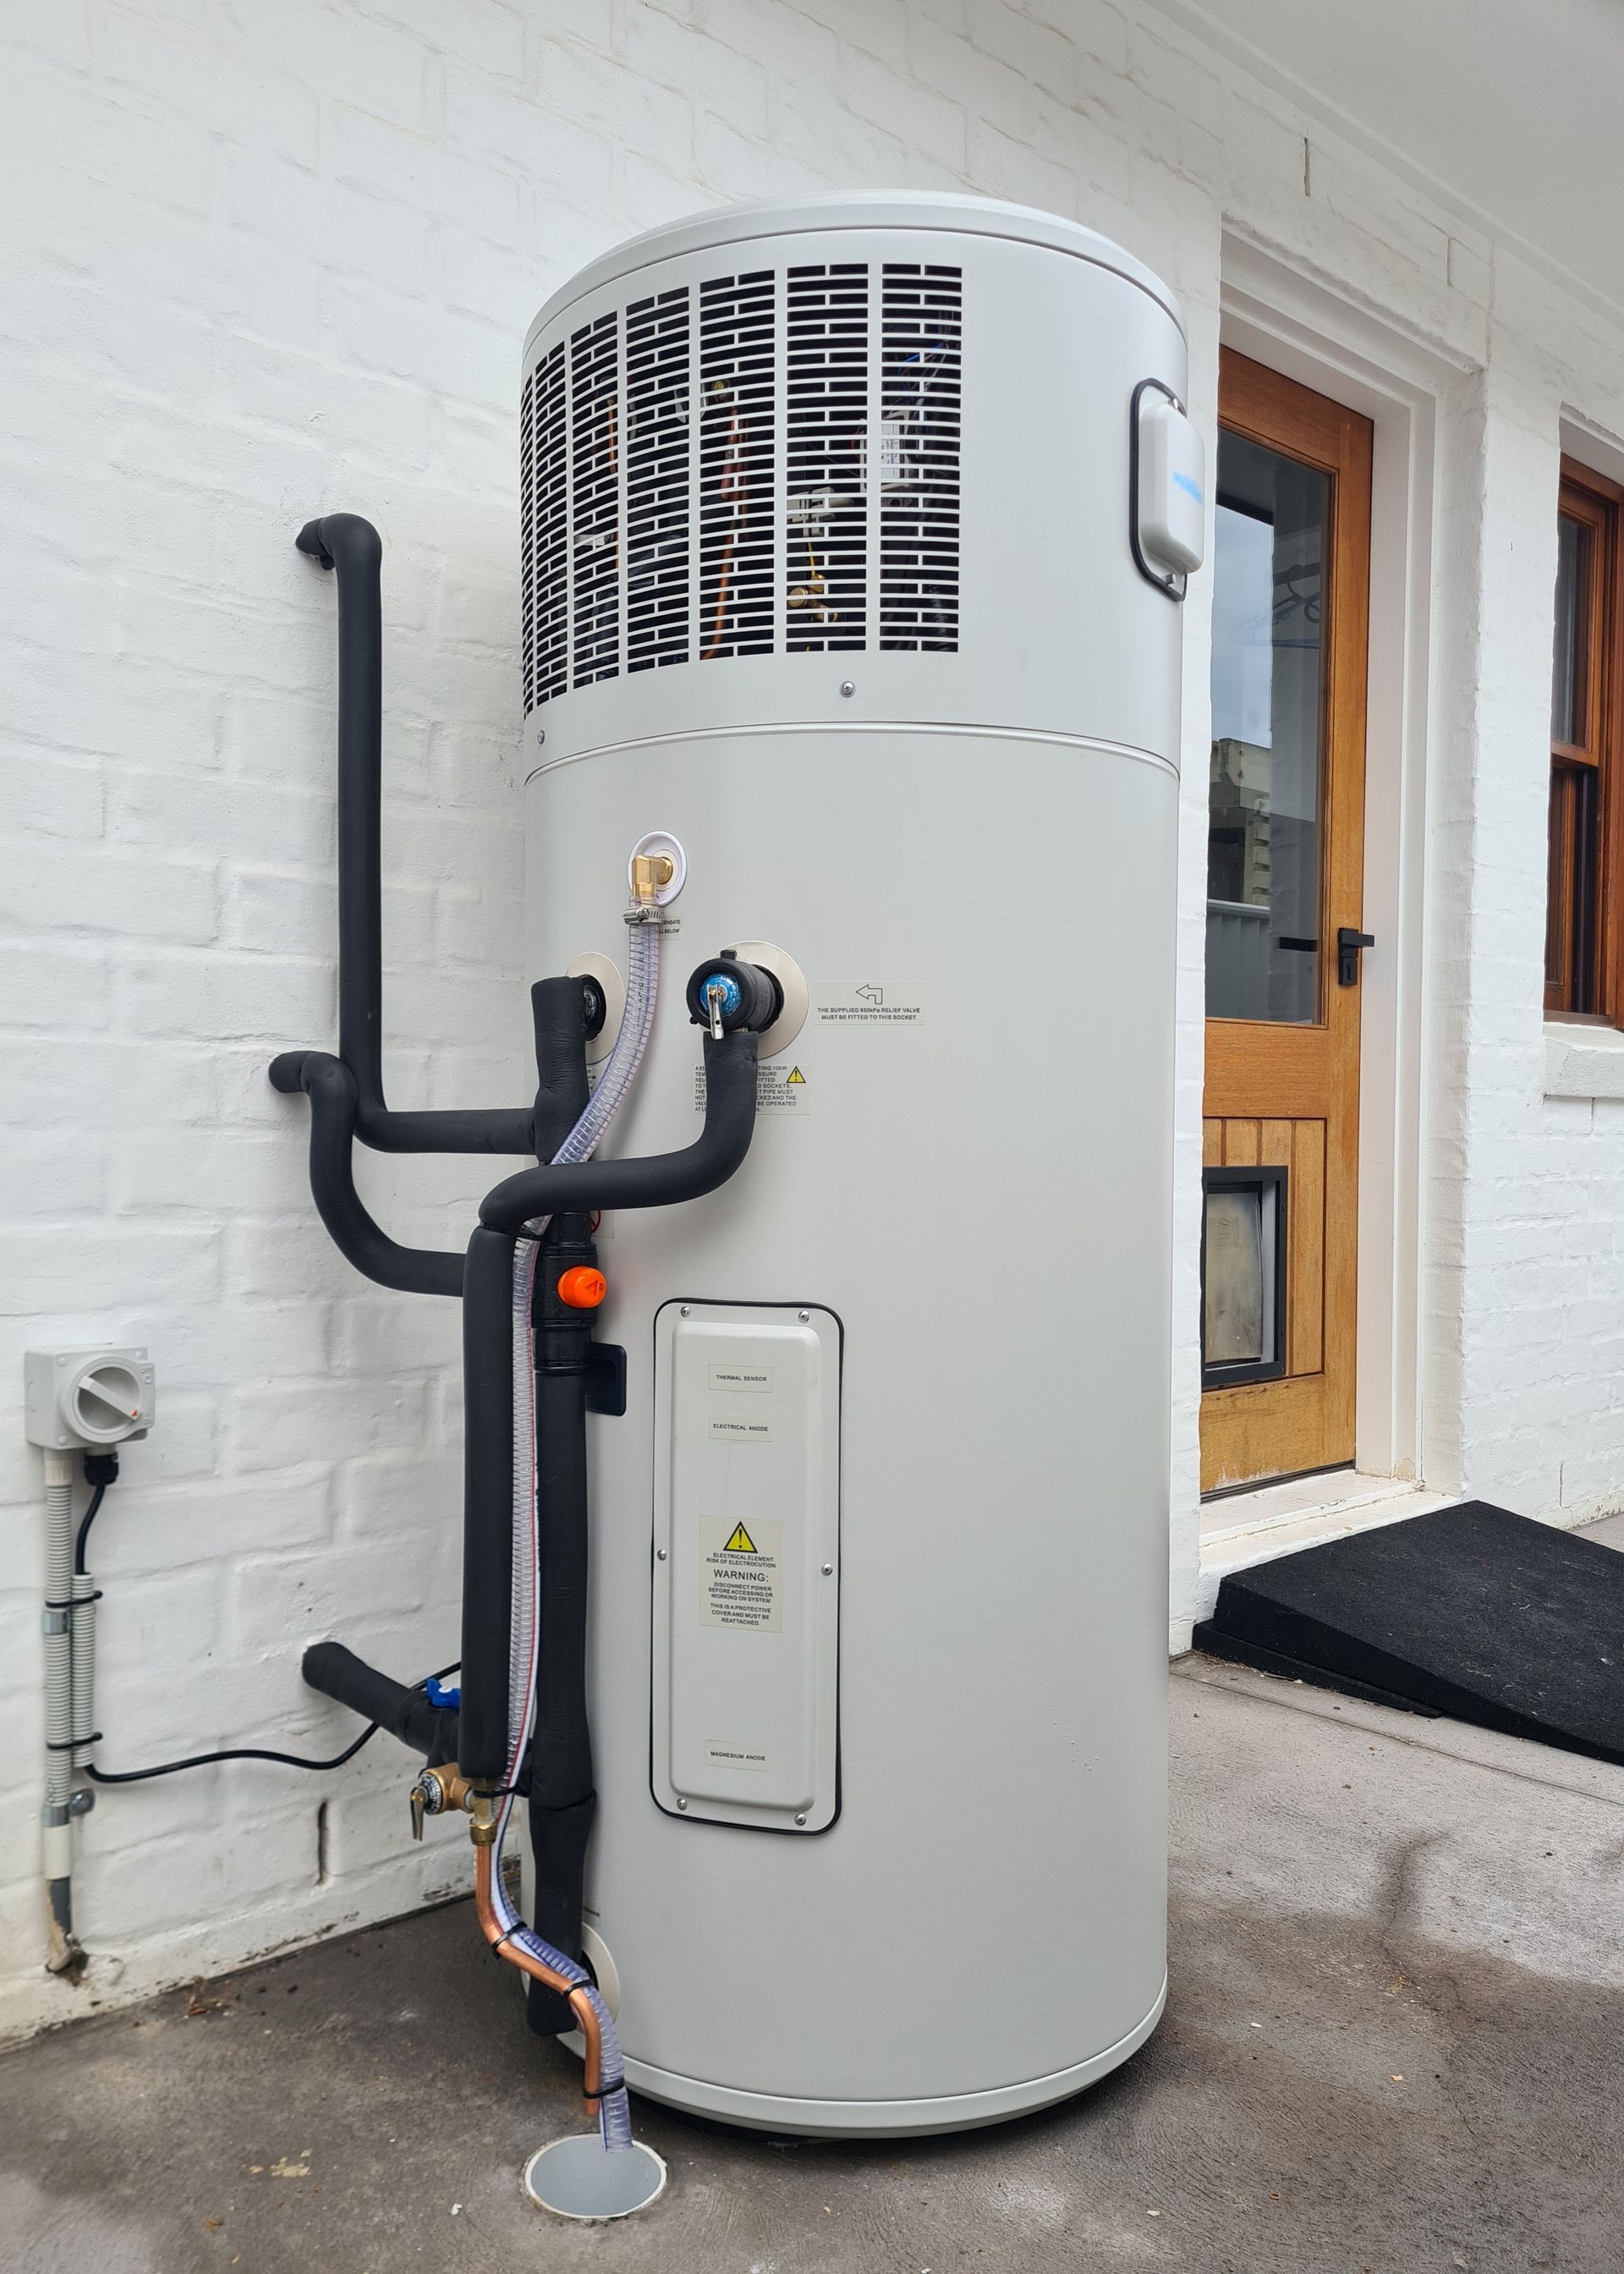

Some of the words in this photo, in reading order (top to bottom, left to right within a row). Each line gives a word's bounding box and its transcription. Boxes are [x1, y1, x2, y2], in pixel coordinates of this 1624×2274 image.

[713, 1552, 747, 1561] ELECTRICAL
[728, 1560, 776, 1568] ELECTROCUTION
[713, 1568, 769, 1583] WARNING:
[721, 1618, 761, 1626] REATTACHED.
